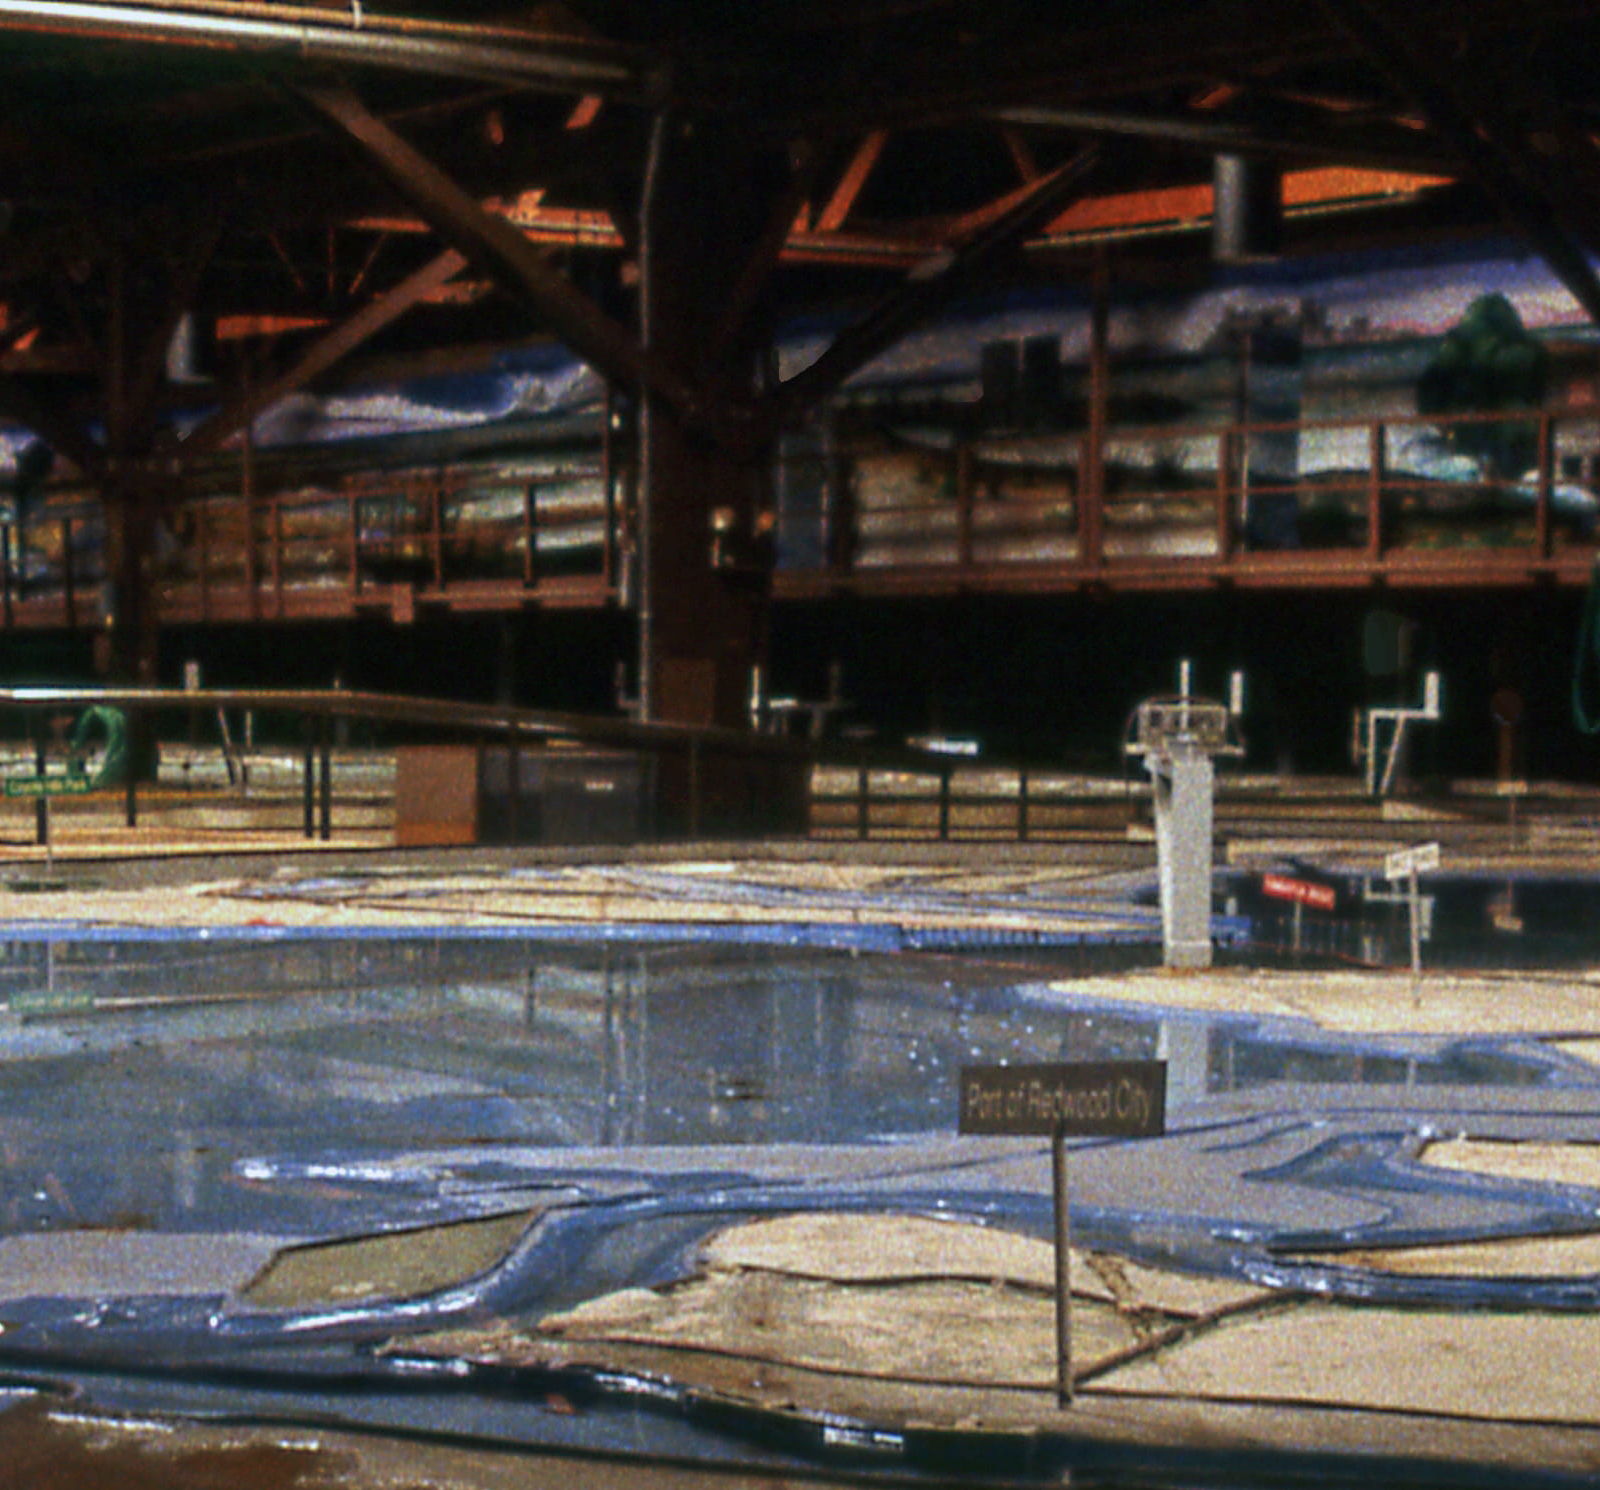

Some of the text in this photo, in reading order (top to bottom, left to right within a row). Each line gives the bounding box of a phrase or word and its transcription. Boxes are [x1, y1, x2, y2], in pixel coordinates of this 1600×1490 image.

[968, 1079, 1150, 1127] Port of Redwood City
